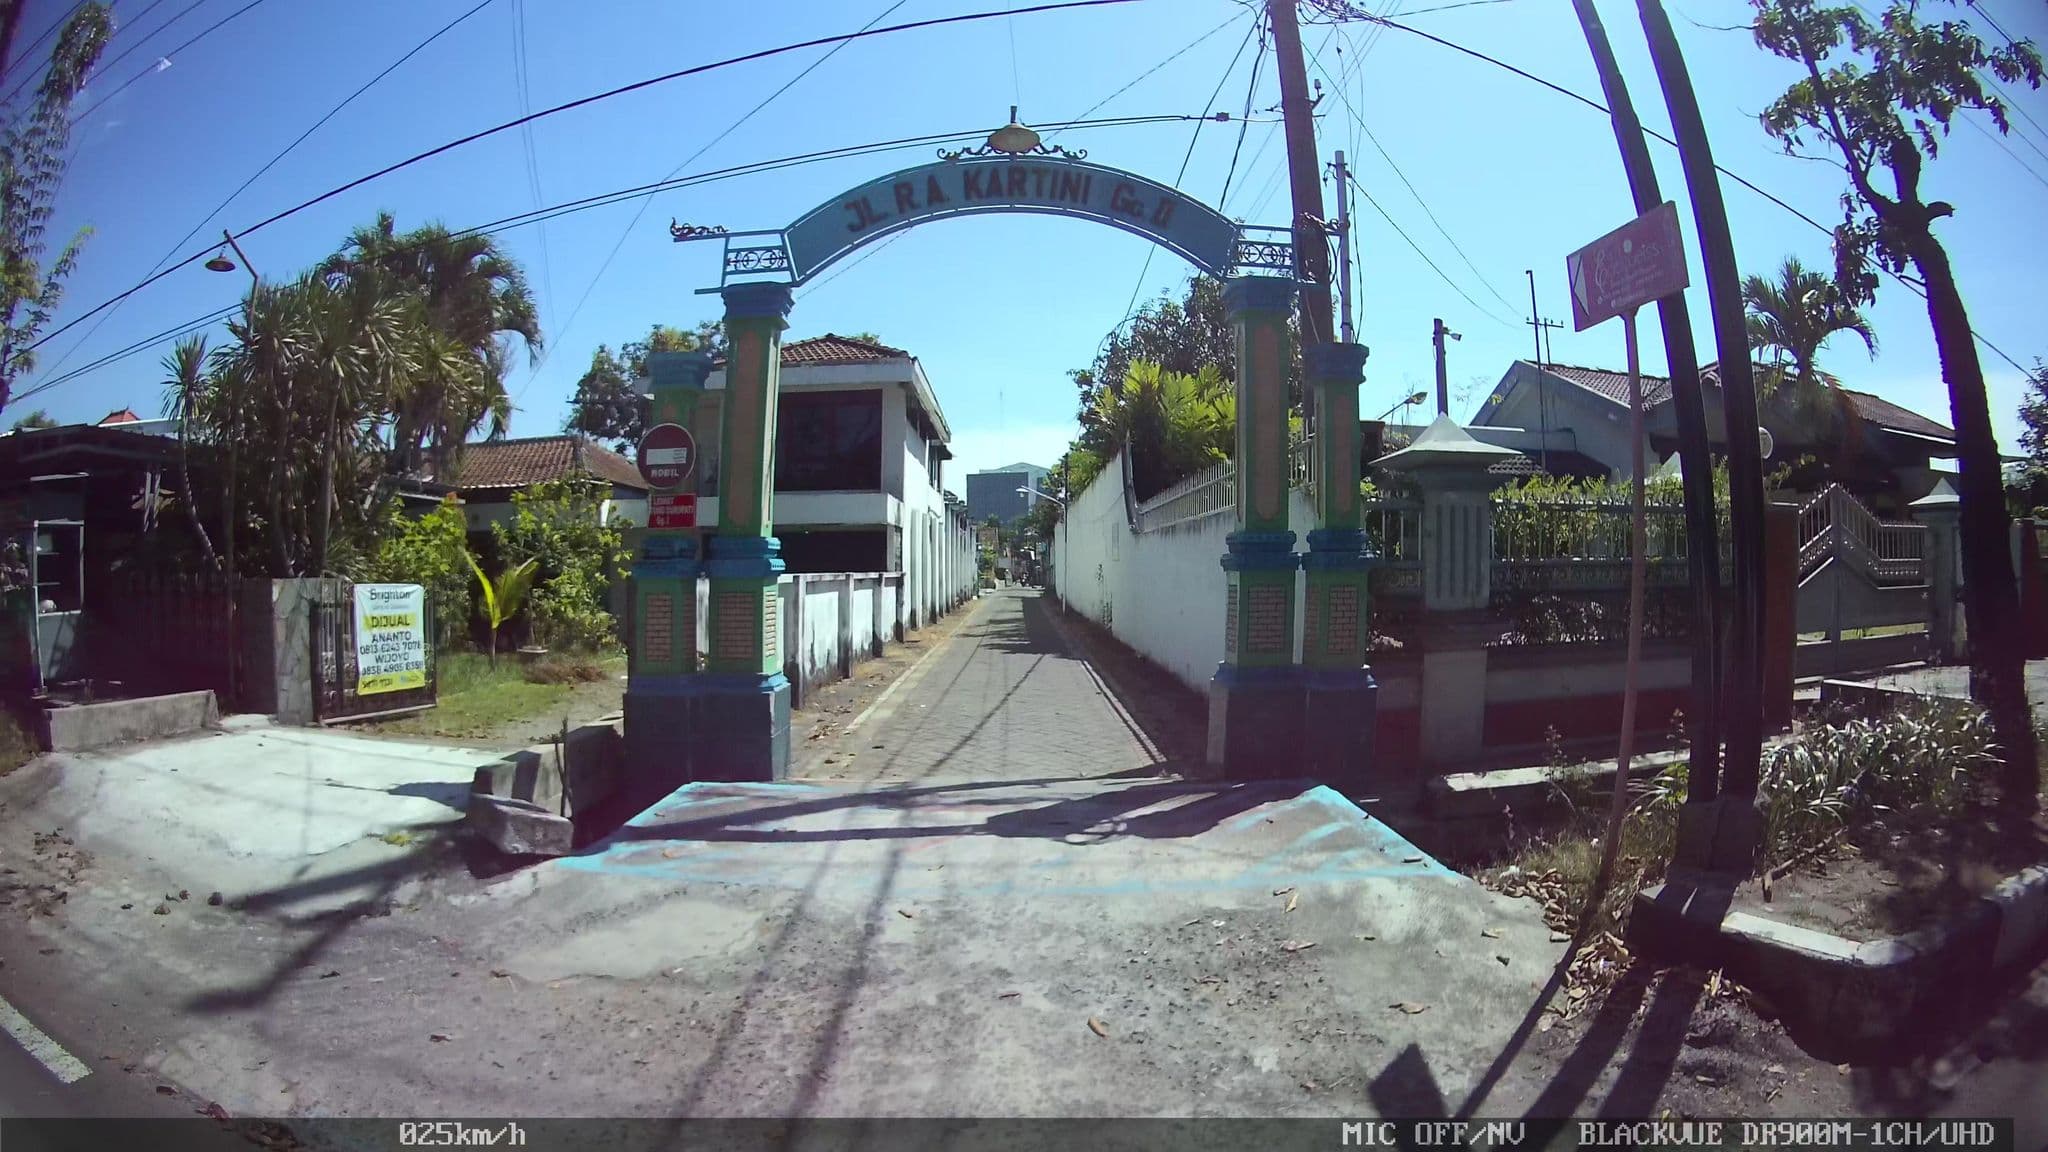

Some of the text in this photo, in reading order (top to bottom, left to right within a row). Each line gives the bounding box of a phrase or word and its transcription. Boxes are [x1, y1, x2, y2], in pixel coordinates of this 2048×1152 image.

[963, 165, 1092, 205] KARTINI
[370, 588, 410, 602] Brighton
[371, 615, 410, 628] DIJUAL
[372, 631, 412, 644] ANANTO
[375, 652, 410, 664] WIJOYO
